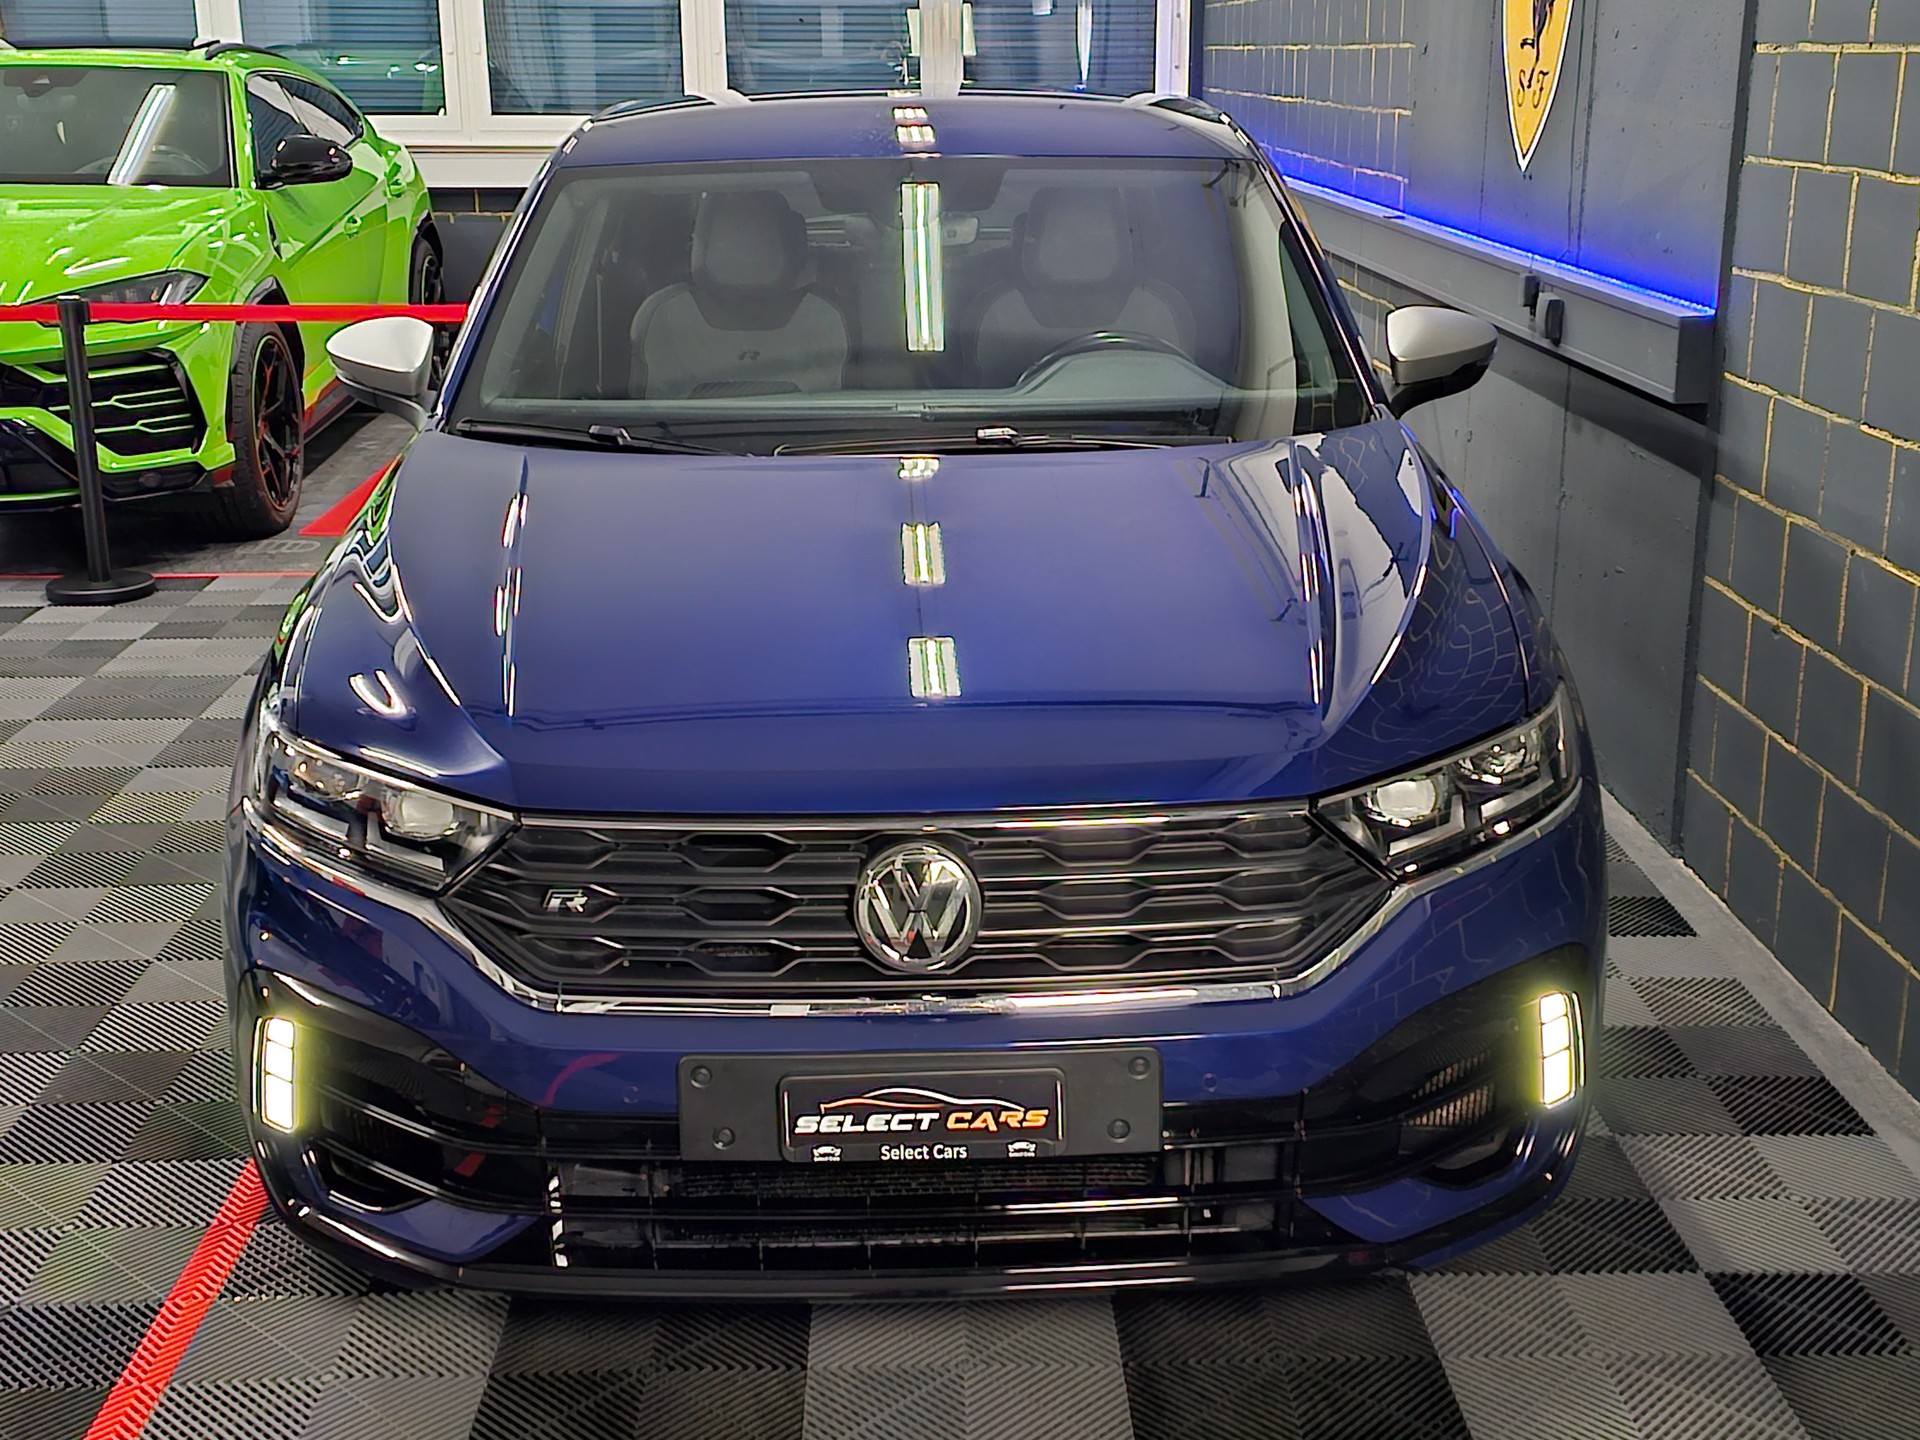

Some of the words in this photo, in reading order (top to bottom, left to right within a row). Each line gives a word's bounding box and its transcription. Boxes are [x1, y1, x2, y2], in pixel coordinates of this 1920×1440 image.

[543, 888, 589, 913] R
[858, 847, 976, 968] VW
[794, 1112, 940, 1134] SELECT
[946, 1108, 1050, 1132] CARS
[880, 1144, 930, 1160] Select
[933, 1143, 968, 1159] Cars
